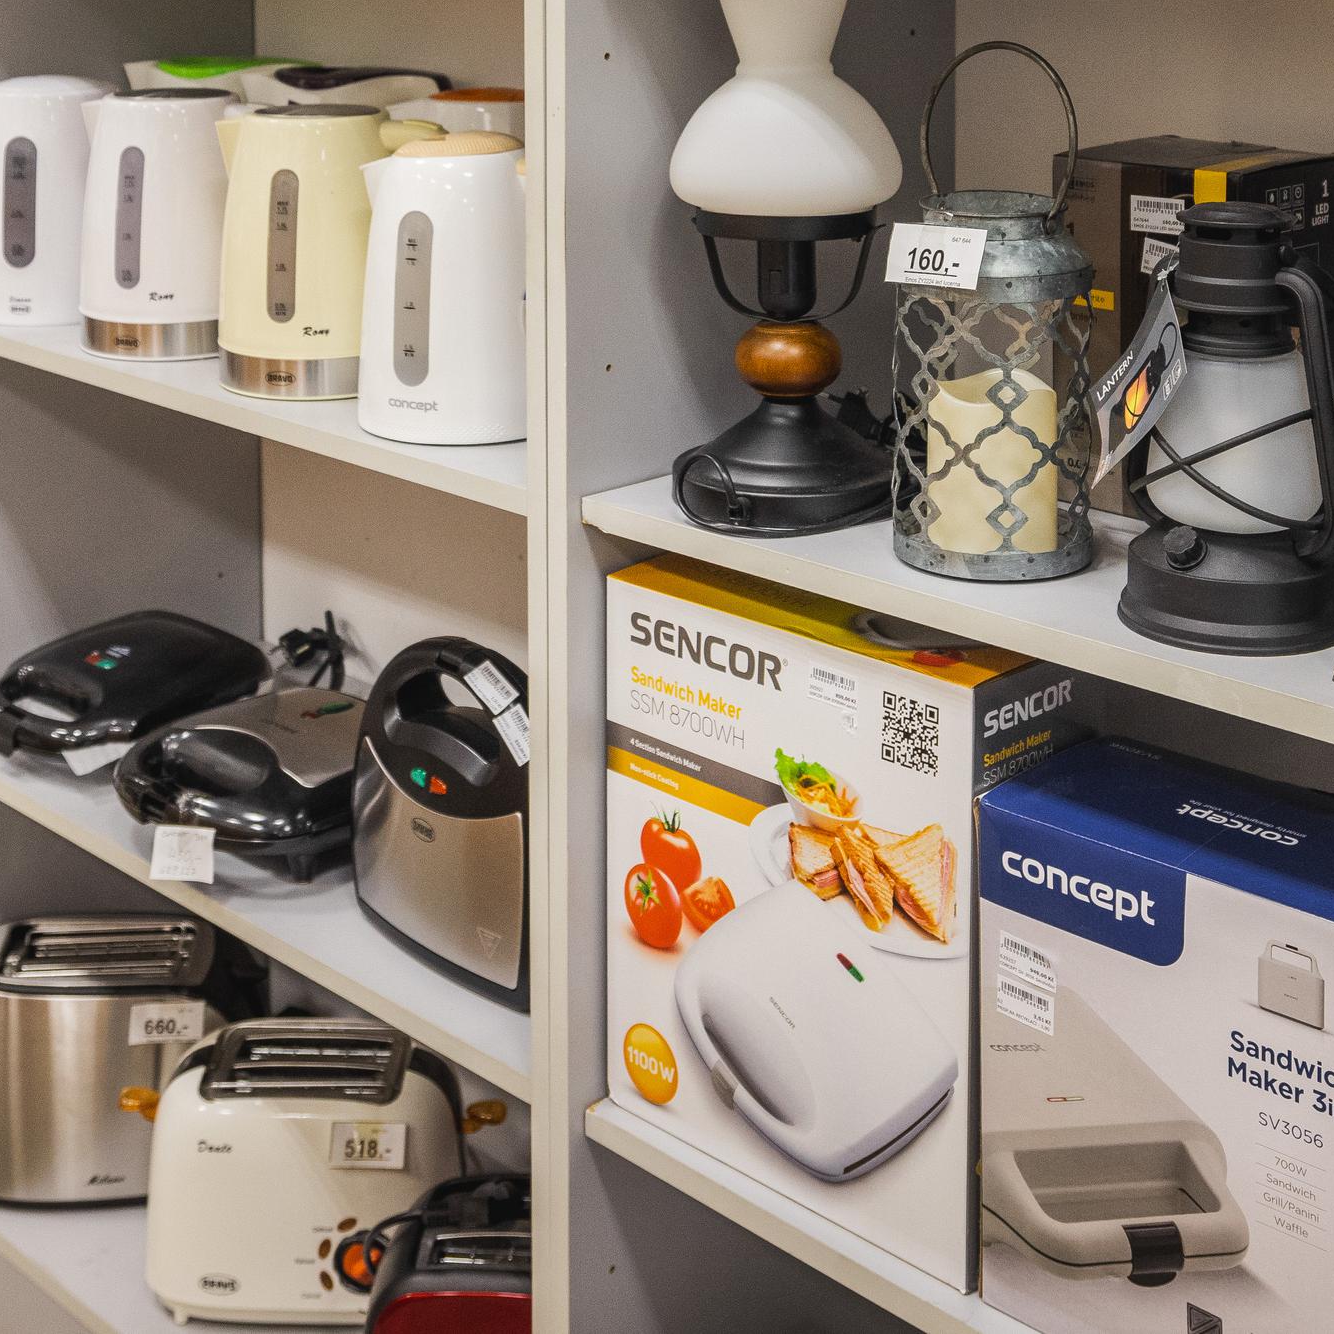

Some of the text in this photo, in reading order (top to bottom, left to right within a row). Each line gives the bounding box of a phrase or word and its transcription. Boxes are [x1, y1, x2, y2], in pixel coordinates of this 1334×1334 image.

[1322, 179, 1329, 198] 1
[1312, 215, 1329, 227] LIGHT
[1315, 203, 1329, 215] LED
[908, 247, 960, 276] 160,-
[943, 279, 960, 287] lucerna
[303, 326, 330, 337] Rony
[267, 373, 294, 384] BRAVO
[1096, 350, 1134, 401] LANTERN
[388, 397, 439, 413] concept
[630, 611, 782, 692] SENCOR
[631, 666, 742, 720] Sandwich Maker
[630, 690, 745, 749] SSM 8700WH
[983, 679, 1072, 738] SENCOR
[635, 740, 655, 755] Section
[656, 745, 682, 765] Sandwich
[683, 758, 701, 772] Maker
[984, 730, 1051, 767] Sandwich Maker
[630, 763, 679, 790] Non-stick Coating
[983, 745, 1054, 787] SSM 8700WH
[1175, 804, 1299, 846] concept
[1002, 850, 1155, 927] concept
[990, 1043, 1046, 1052] concept
[1228, 1057, 1304, 1104] Maker
[1258, 1111, 1324, 1149] SV3056
[1274, 1156, 1307, 1177] 700W
[1266, 1173, 1316, 1201] Sandwich
[1263, 1192, 1320, 1222] Grill/Panini
[1274, 1216, 1309, 1239] Waffle
